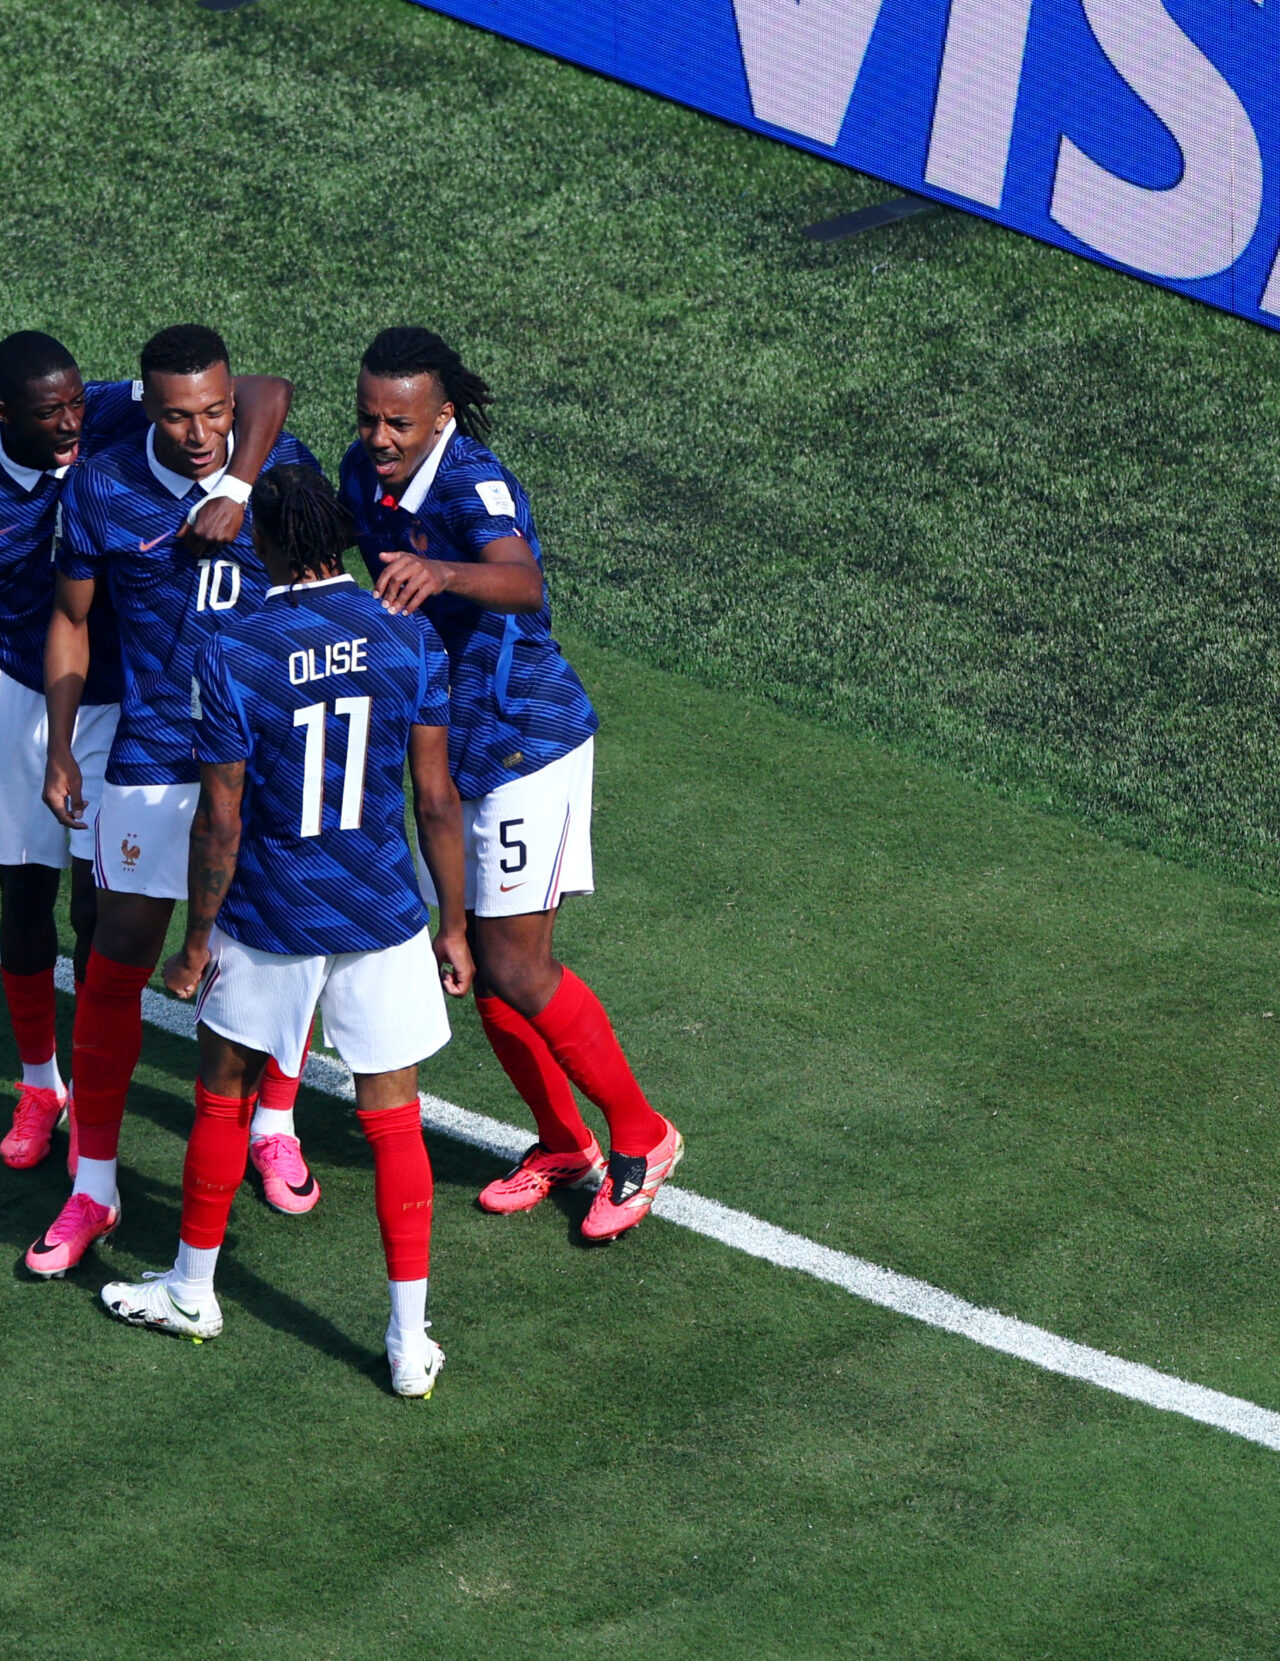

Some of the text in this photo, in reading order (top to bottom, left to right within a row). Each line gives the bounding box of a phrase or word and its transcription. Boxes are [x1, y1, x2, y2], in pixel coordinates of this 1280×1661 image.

[732, 0, 1280, 314] IS
[197, 559, 240, 612] 10
[288, 637, 368, 686] OLISE
[293, 696, 372, 838] 11
[499, 817, 527, 874] 5
